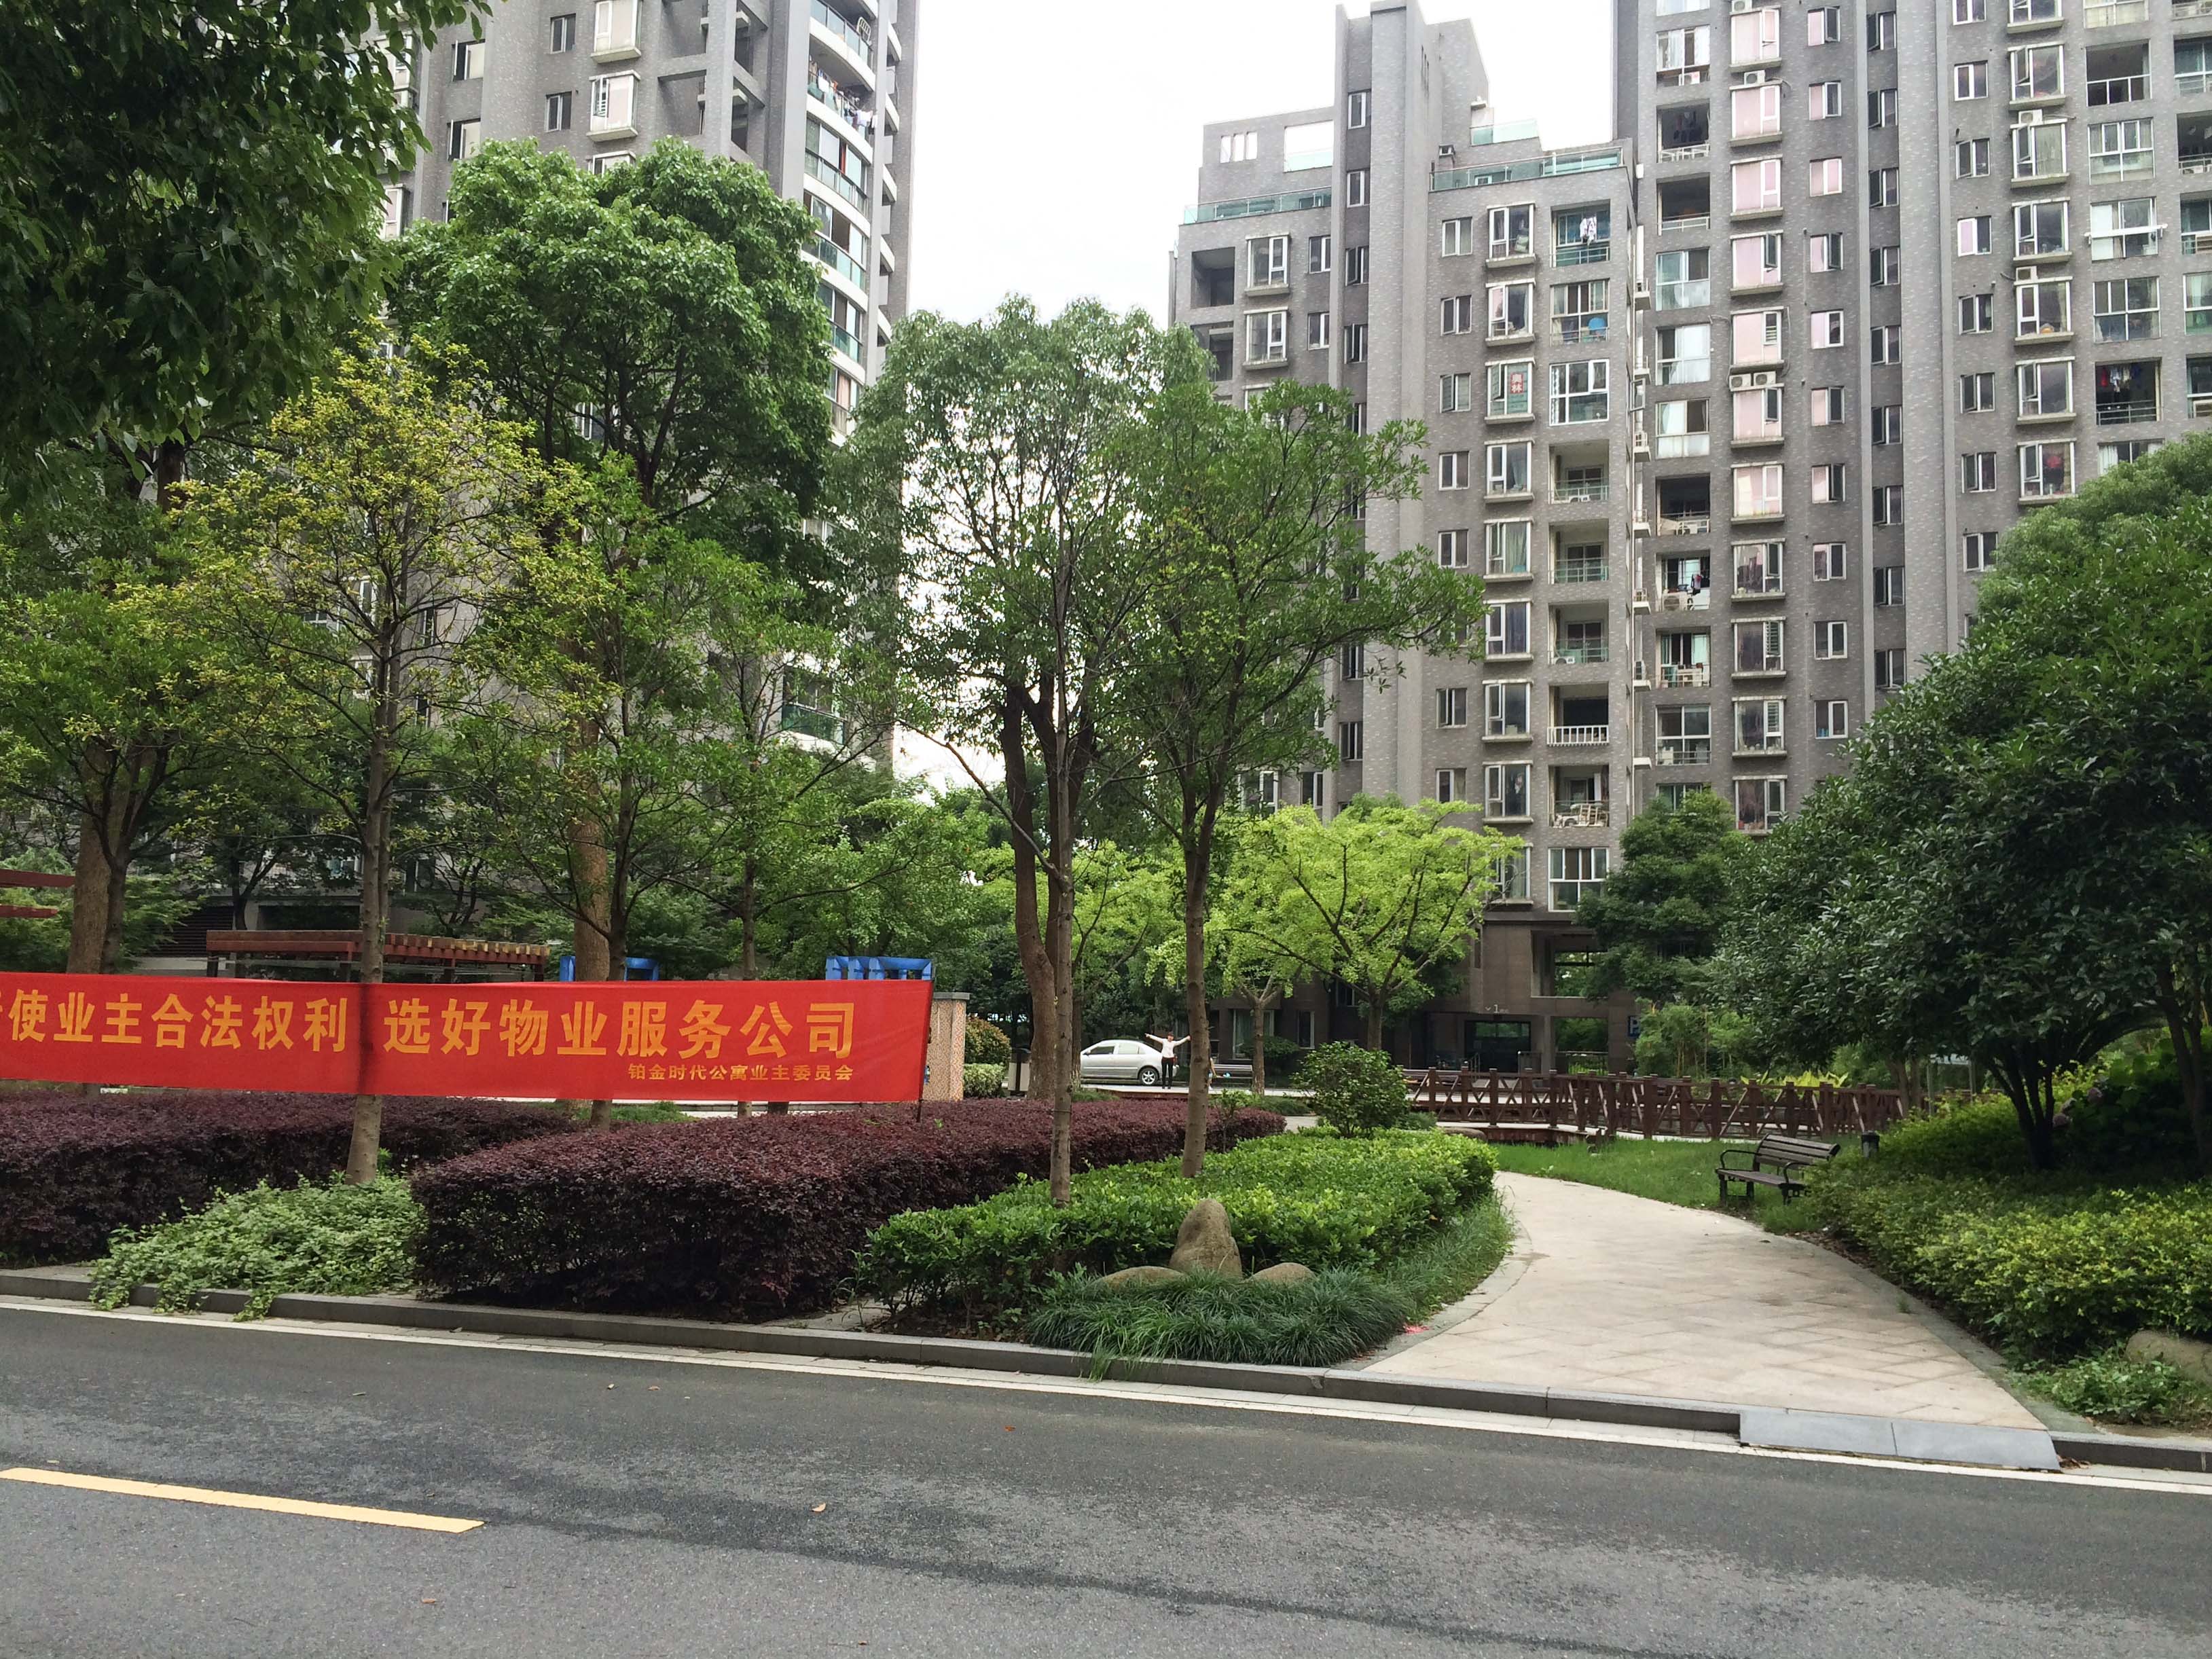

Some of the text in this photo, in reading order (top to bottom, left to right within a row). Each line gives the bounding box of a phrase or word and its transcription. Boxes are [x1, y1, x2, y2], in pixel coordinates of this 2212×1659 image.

[0, 989, 854, 1059] 使业主合法权利 选好物业服务公司
[628, 1063, 854, 1081] 铂金时代公寓业主委员会
